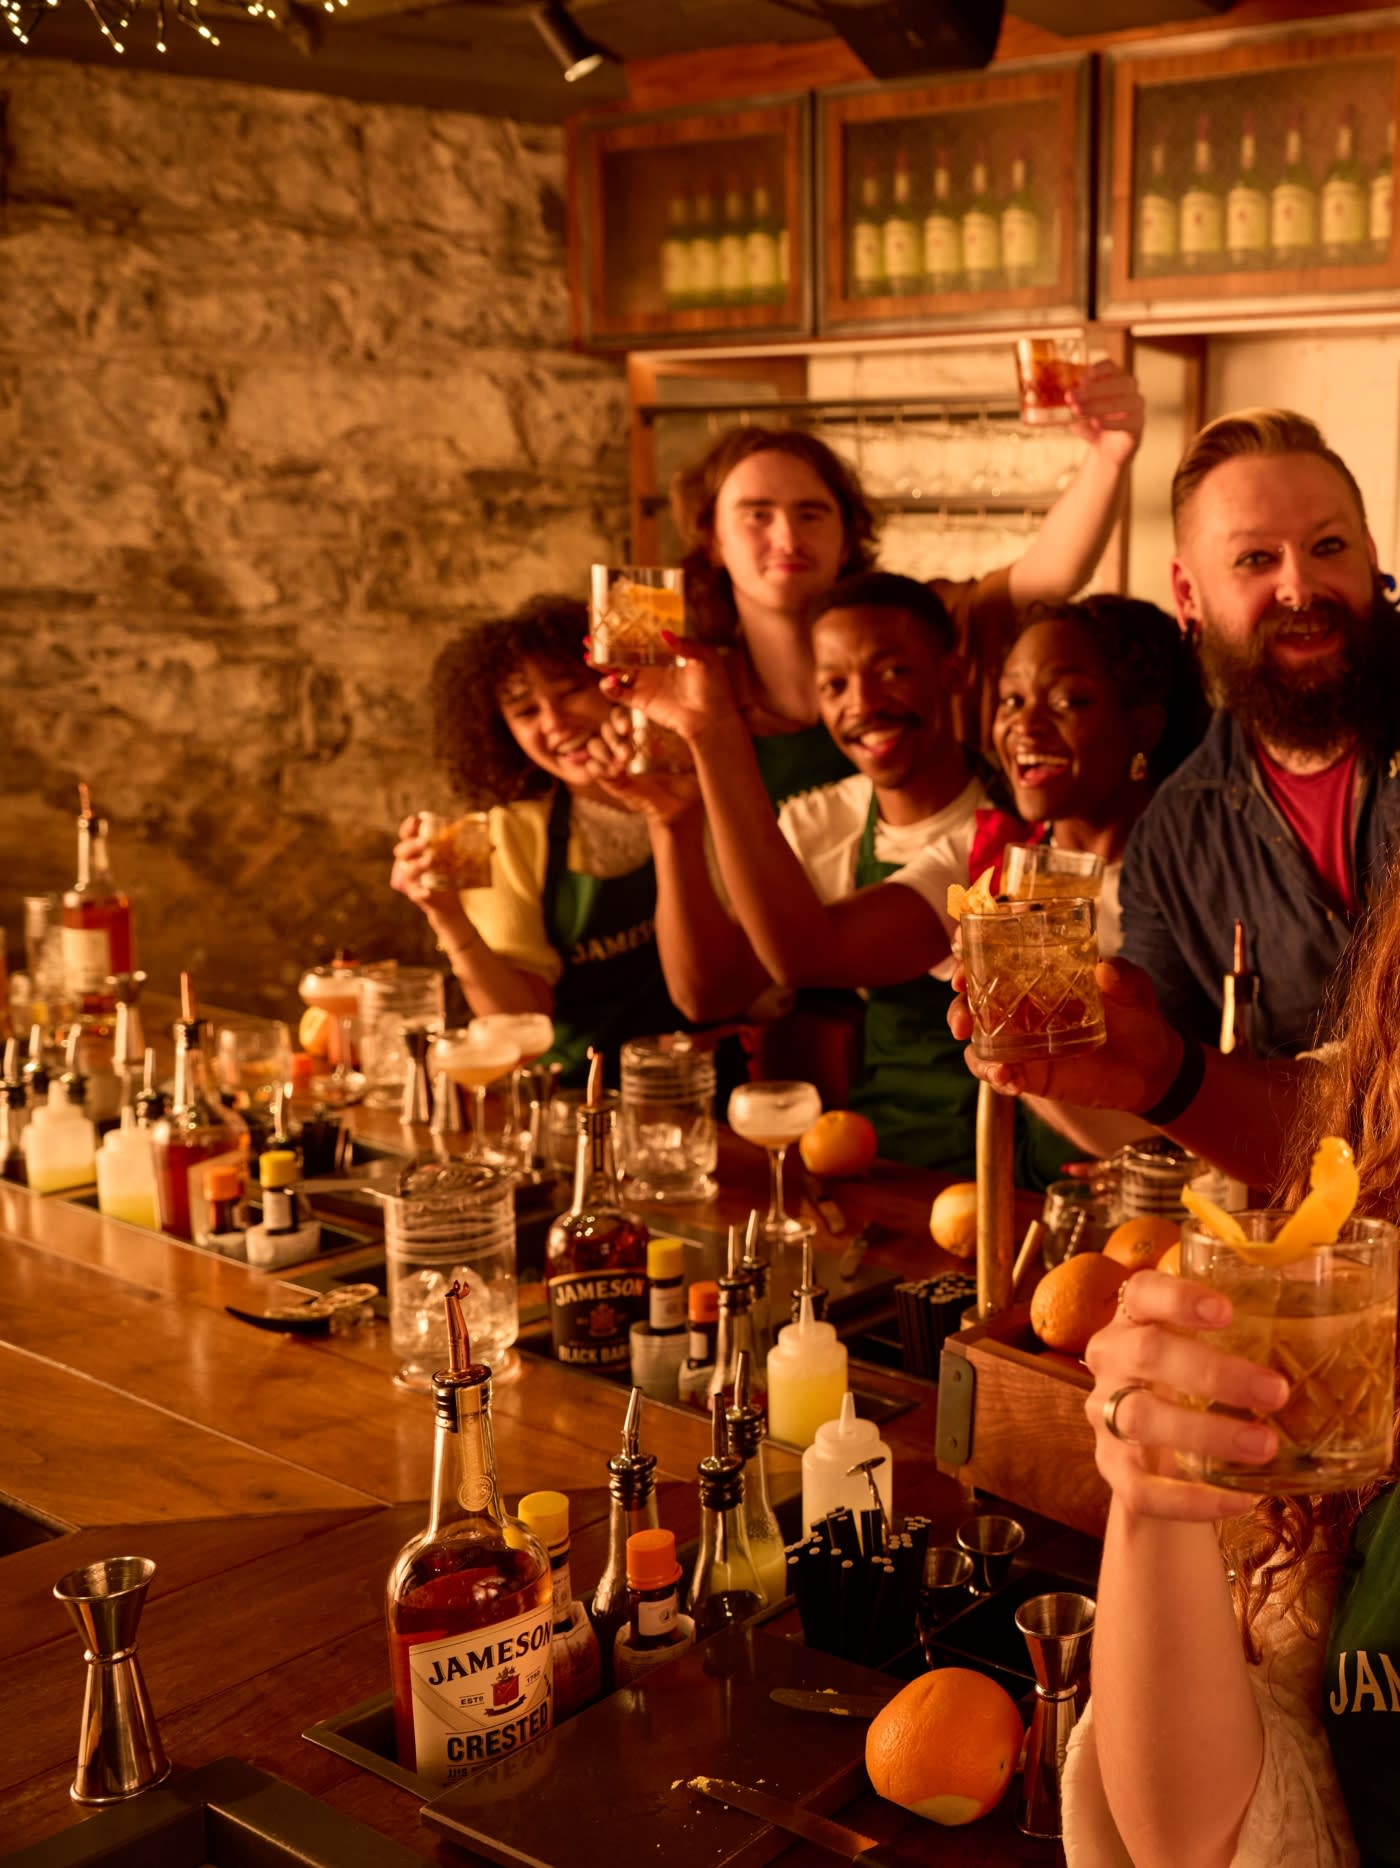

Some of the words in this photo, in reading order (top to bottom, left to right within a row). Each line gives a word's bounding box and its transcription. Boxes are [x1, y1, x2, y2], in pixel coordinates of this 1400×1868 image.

[555, 1279, 645, 1306] JAMESON
[428, 1620, 551, 1686] JAMESON
[447, 1701, 548, 1762] CRESTED
